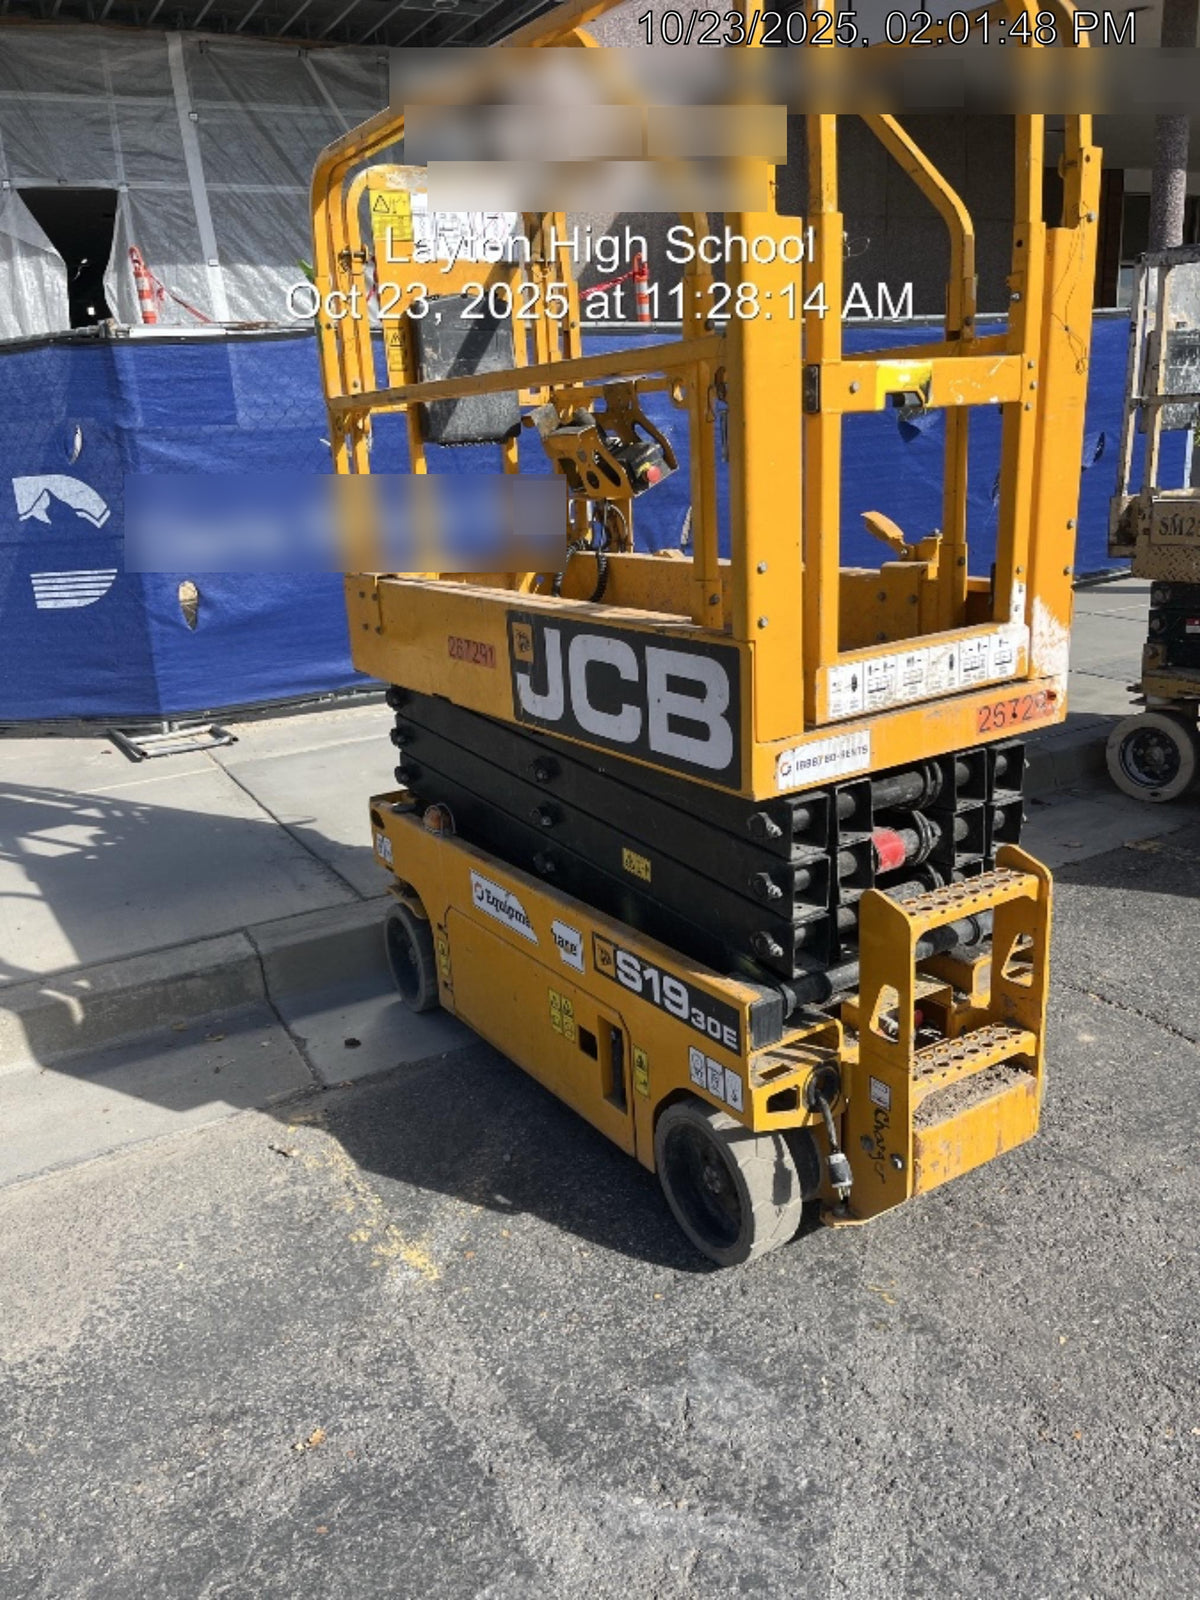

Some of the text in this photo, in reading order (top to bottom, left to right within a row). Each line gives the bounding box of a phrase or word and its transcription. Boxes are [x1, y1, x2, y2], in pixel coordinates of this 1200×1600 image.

[1159, 513, 1200, 537] SM2
[447, 636, 496, 668] 267291
[515, 627, 733, 770] JCB
